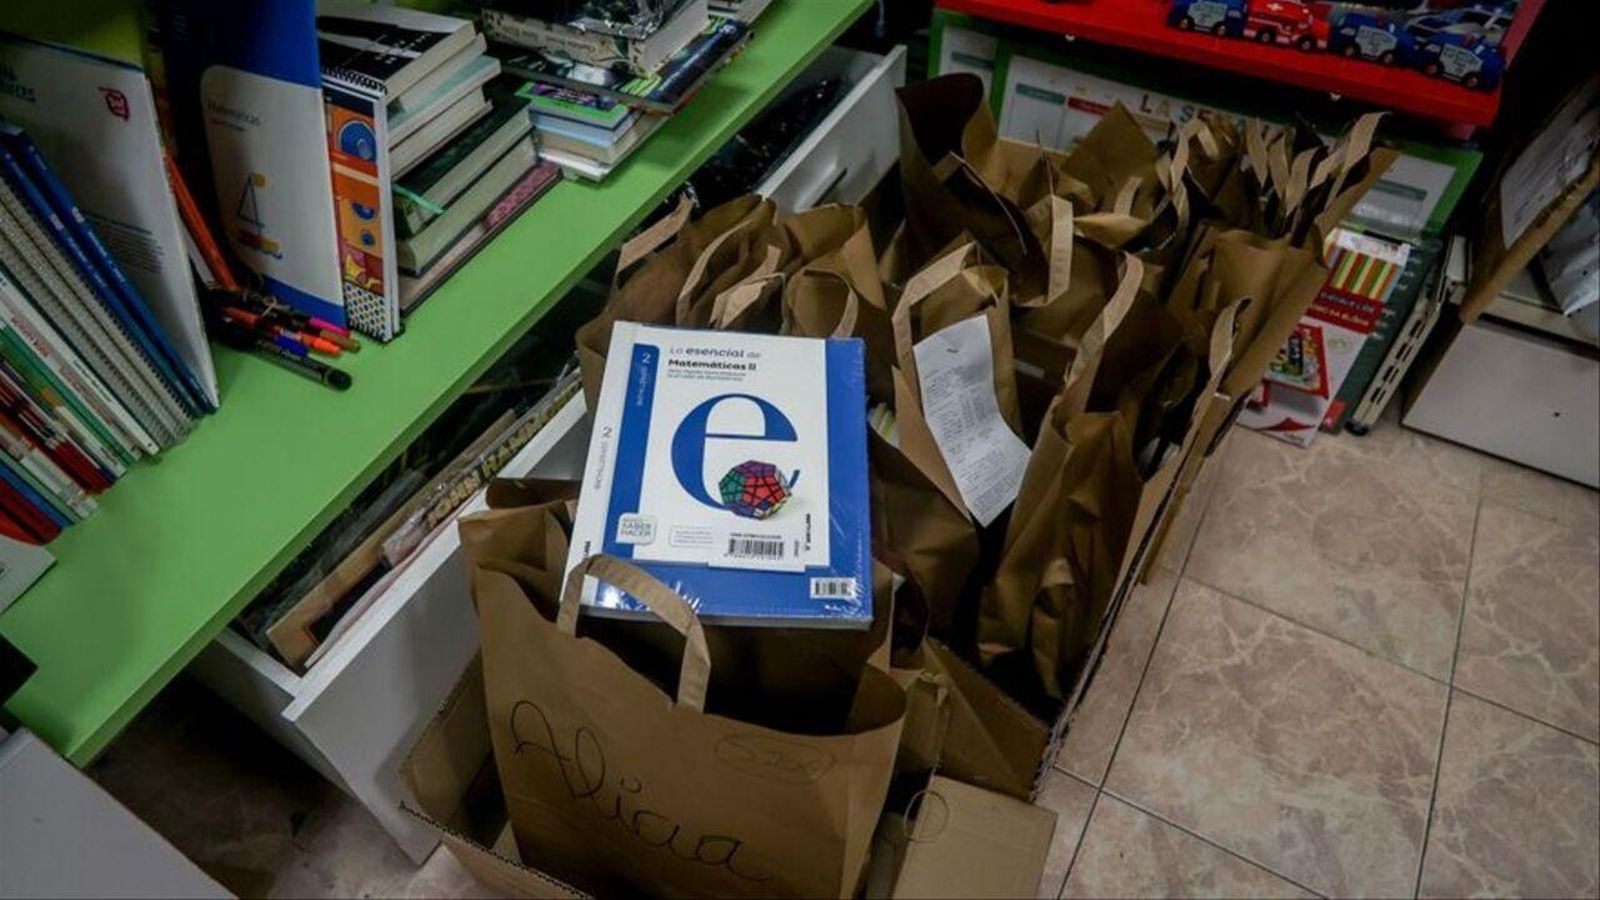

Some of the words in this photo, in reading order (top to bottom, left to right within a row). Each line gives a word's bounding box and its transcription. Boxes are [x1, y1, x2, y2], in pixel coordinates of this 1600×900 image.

[642, 352, 651, 364] 2
[685, 347, 744, 358] esencial
[667, 358, 746, 371] Matemáticas
[602, 425, 613, 439] 2
